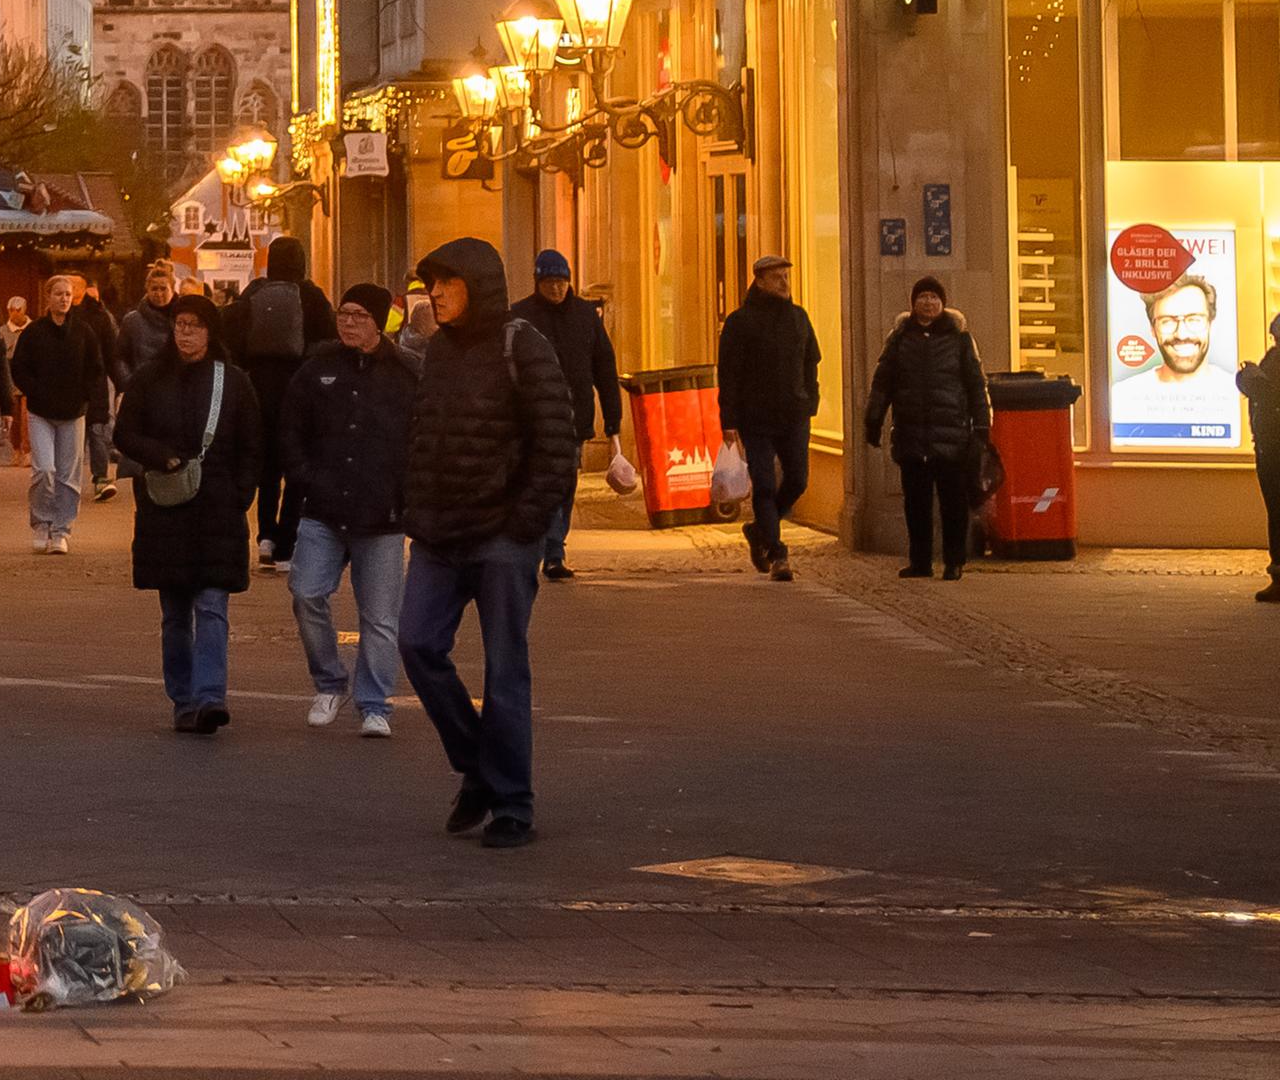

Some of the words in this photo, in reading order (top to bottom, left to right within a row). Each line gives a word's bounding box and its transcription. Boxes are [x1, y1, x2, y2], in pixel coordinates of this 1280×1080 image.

[1116, 246, 1155, 257] GLÄSER
[1156, 248, 1177, 258] DER
[1124, 259, 1133, 268] 2.
[1135, 259, 1170, 269] BRILLE
[1121, 270, 1173, 280] INKLUSIVE
[1190, 425, 1227, 437] KIND
